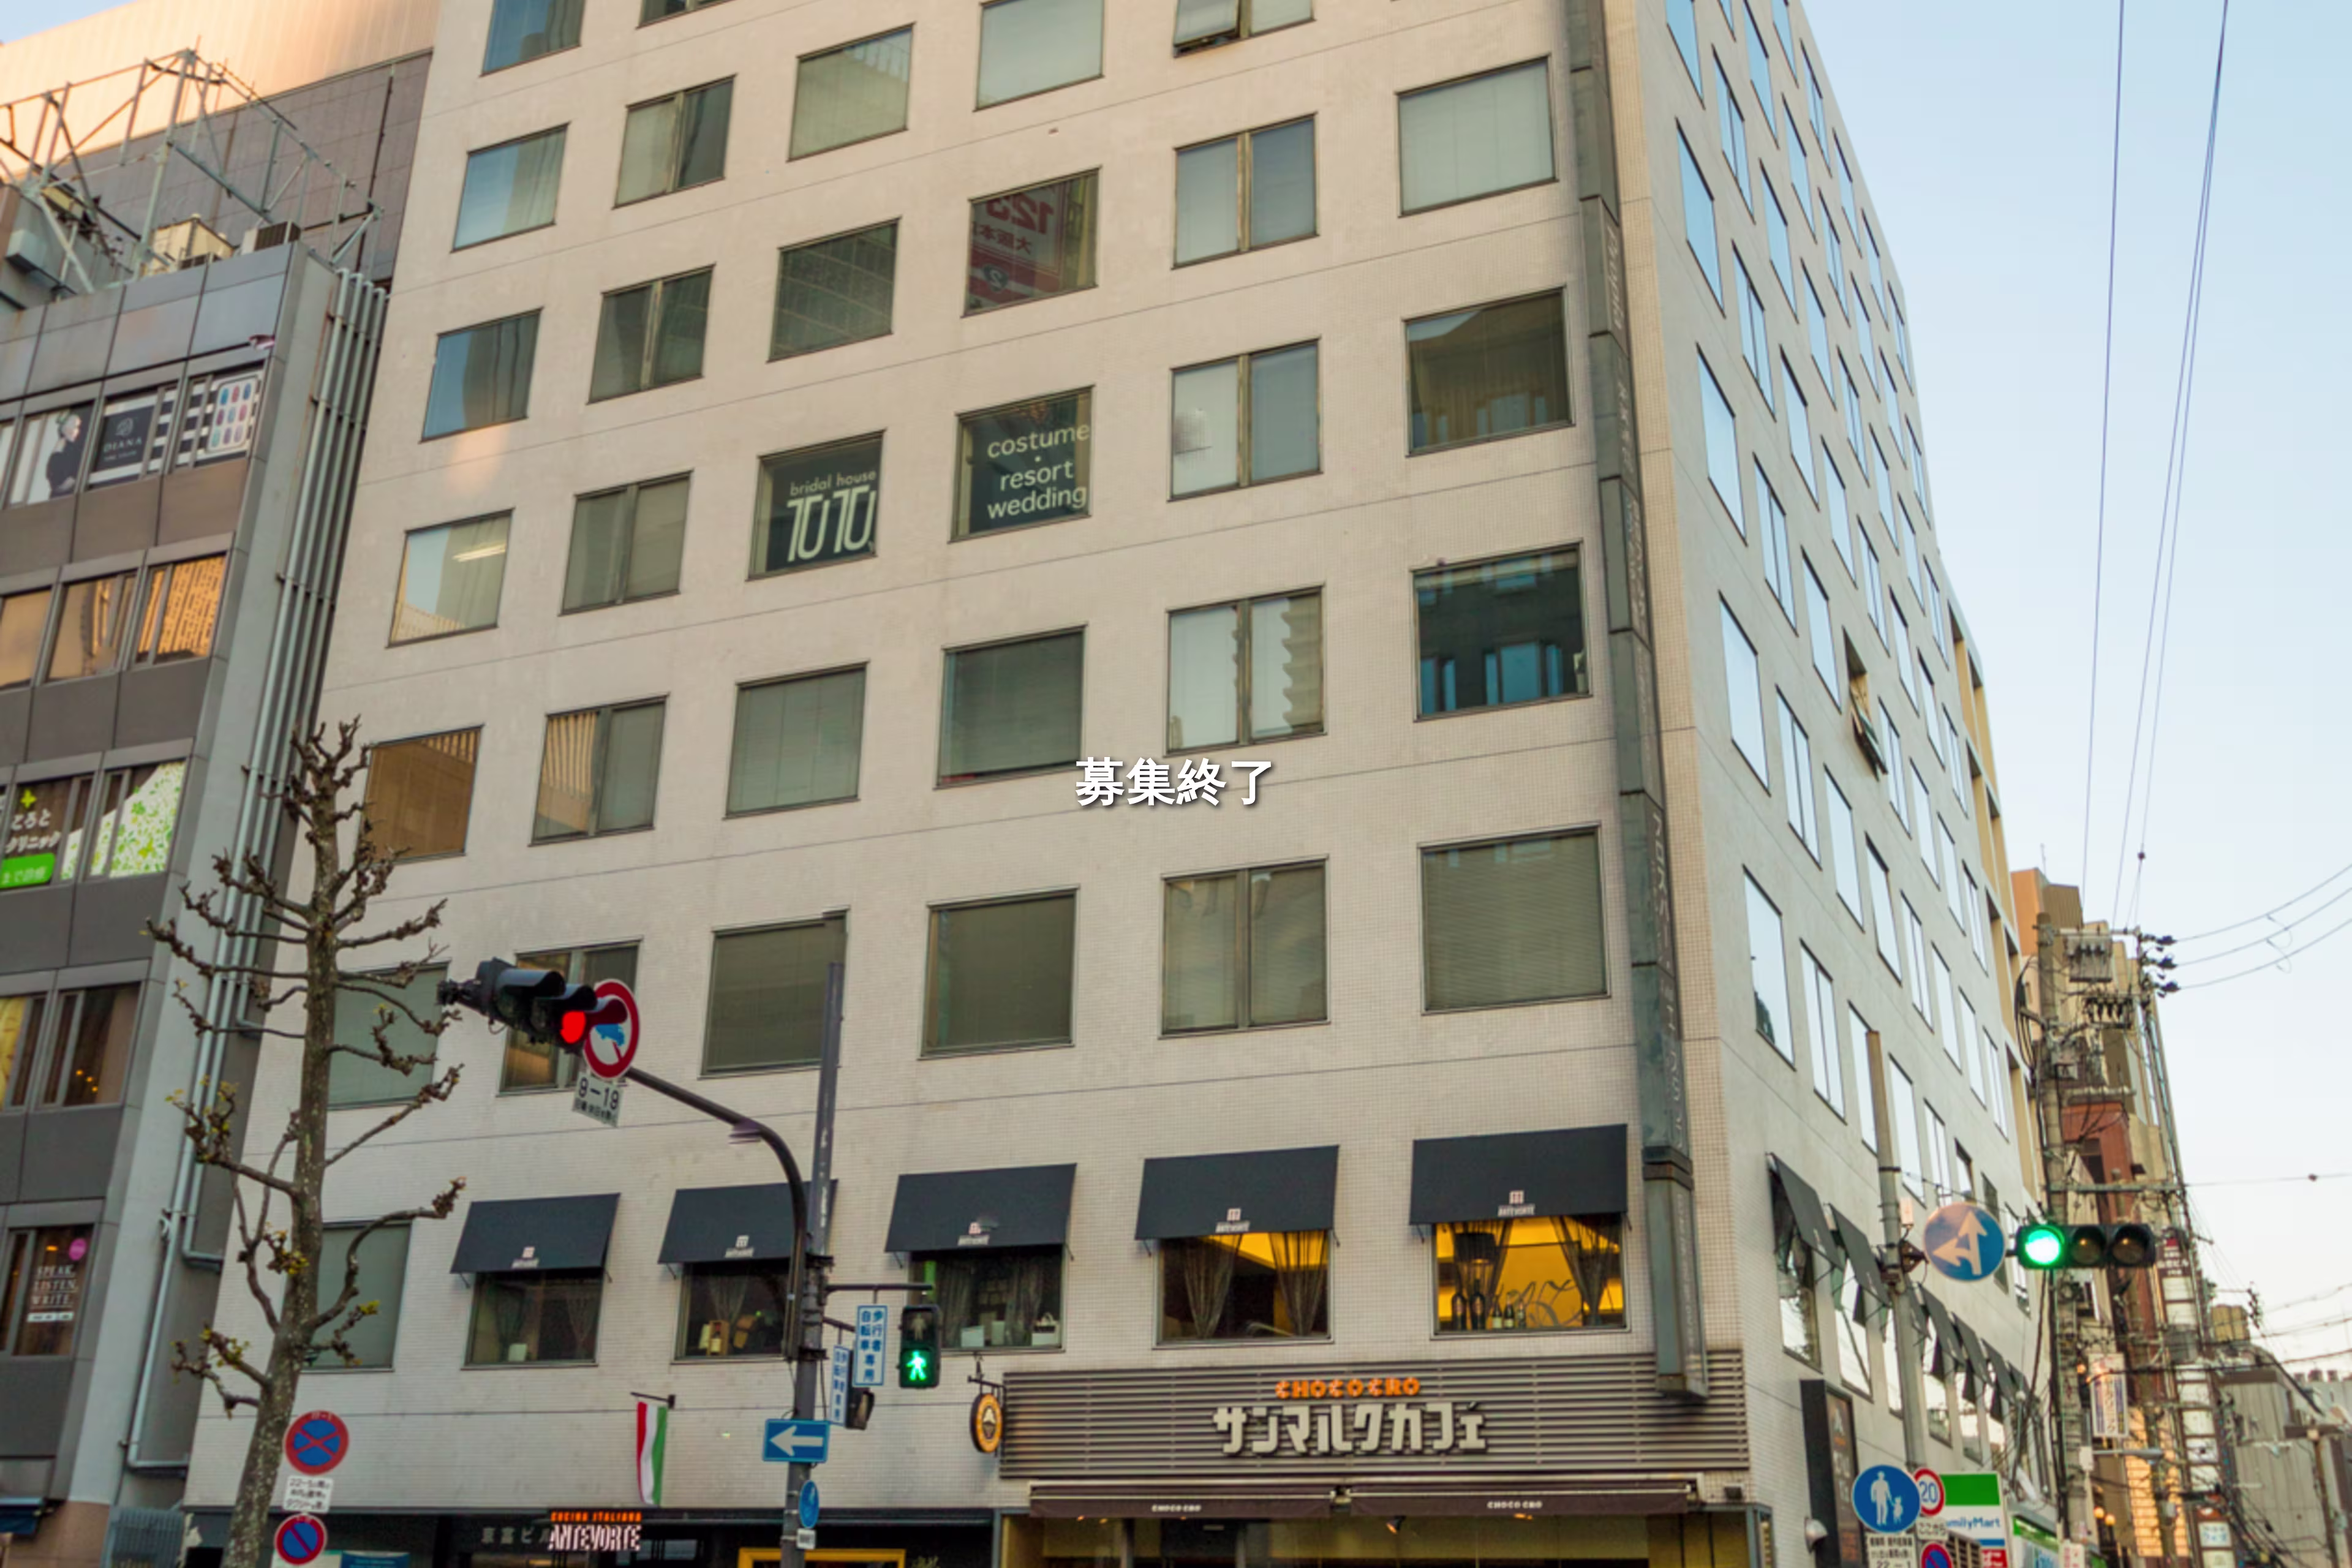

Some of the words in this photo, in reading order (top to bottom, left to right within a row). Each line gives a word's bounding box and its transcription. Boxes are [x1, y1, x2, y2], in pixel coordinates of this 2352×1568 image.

[987, 424, 1090, 459] costume
[790, 473, 832, 496] bridal
[837, 470, 877, 488] house
[1000, 461, 1074, 491] resort
[987, 486, 1087, 519] wedding
[5, 831, 61, 854] クリニック
[1275, 1379, 1364, 1399] CHOCO
[1367, 1376, 1420, 1396] CRO
[1213, 1401, 1487, 1453] サンマルクカフェ
[1919, 1480, 1939, 1504] 20
[1945, 1516, 2000, 1530] amilyMart
[547, 1523, 643, 1552] ANTEVORTE
